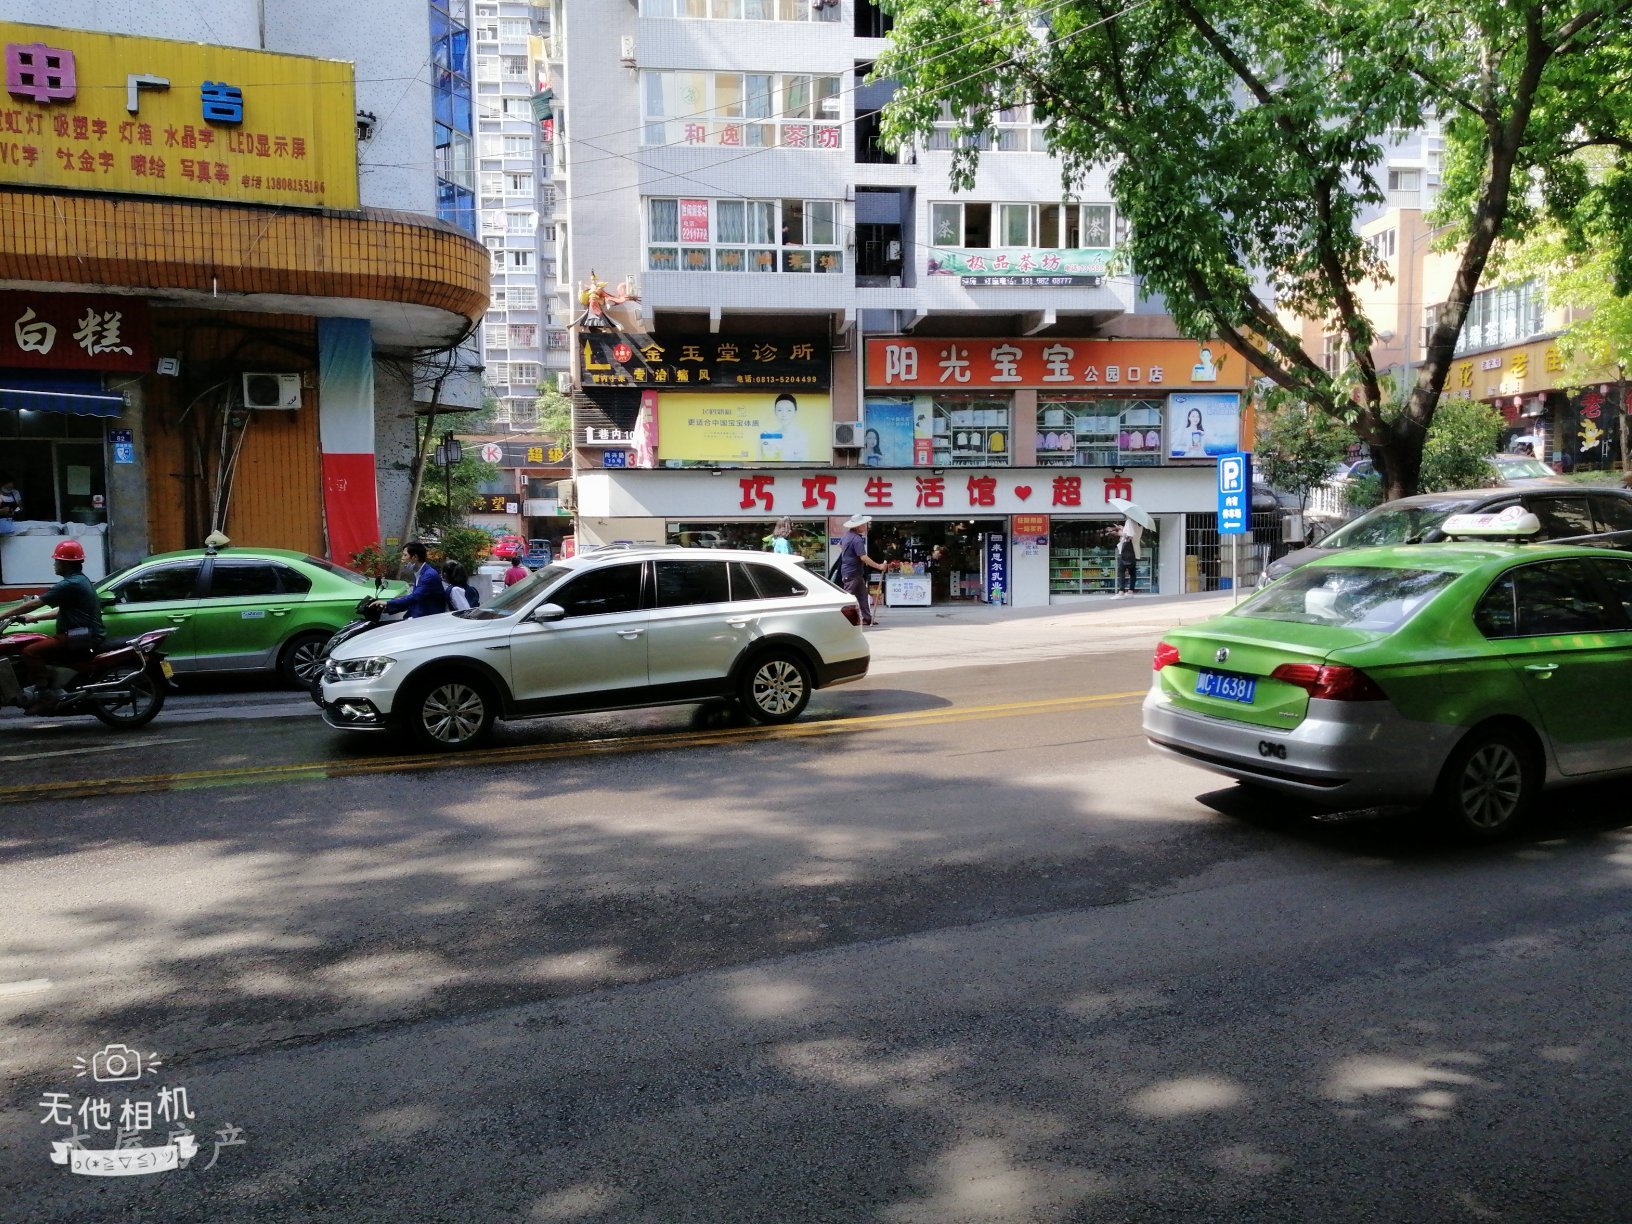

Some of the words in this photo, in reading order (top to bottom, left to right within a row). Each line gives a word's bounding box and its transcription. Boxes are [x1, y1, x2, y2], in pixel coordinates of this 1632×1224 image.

[0, 110, 43, 136] 虹灯
[54, 113, 108, 141] 吸塑字
[118, 121, 153, 147] 灯箱
[164, 124, 215, 150] 水晶字
[228, 131, 307, 160] LED显示屏
[685, 123, 839, 148] 和逸茶坊
[131, 154, 166, 179] 喷绘
[180, 159, 230, 186] 写真等
[241, 174, 262, 189] 电话
[937, 220, 954, 238] 茶
[1087, 220, 1105, 238] 茶
[966, 253, 1061, 273] 极品茶坊
[640, 343, 814, 363] 金玉堂诊所
[885, 343, 1076, 384] 阳光宝宝
[1084, 364, 1164, 384] 公园口店
[633, 367, 711, 383] 专治痛风
[739, 474, 995, 511] 巧巧生活馆
[1051, 474, 1134, 507] 超市
[1222, 508, 1242, 519] 停车场
[1258, 740, 1287, 761] CNG
